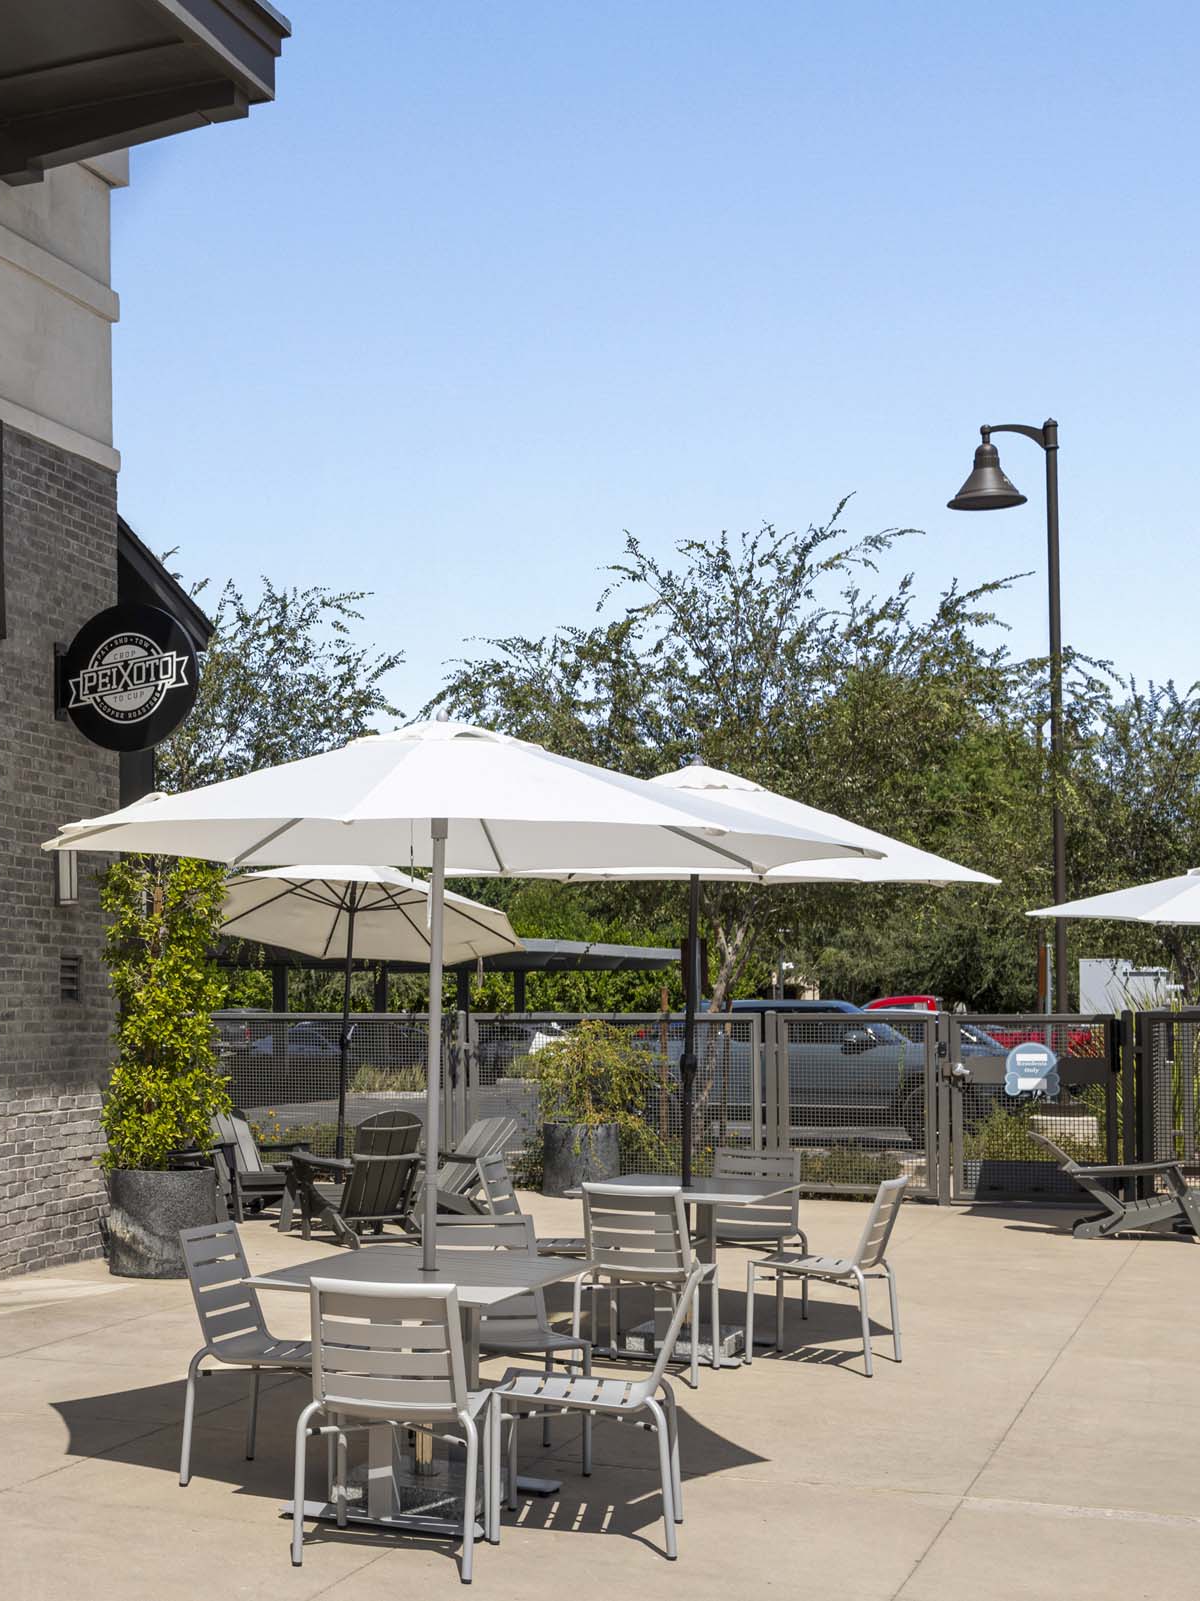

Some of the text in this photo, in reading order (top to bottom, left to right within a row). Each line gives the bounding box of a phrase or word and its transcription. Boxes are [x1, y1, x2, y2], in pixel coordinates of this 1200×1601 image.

[83, 656, 172, 694] PEIXOTO
[113, 691, 145, 703] TO CUP
[99, 701, 124, 719] COFFEE
